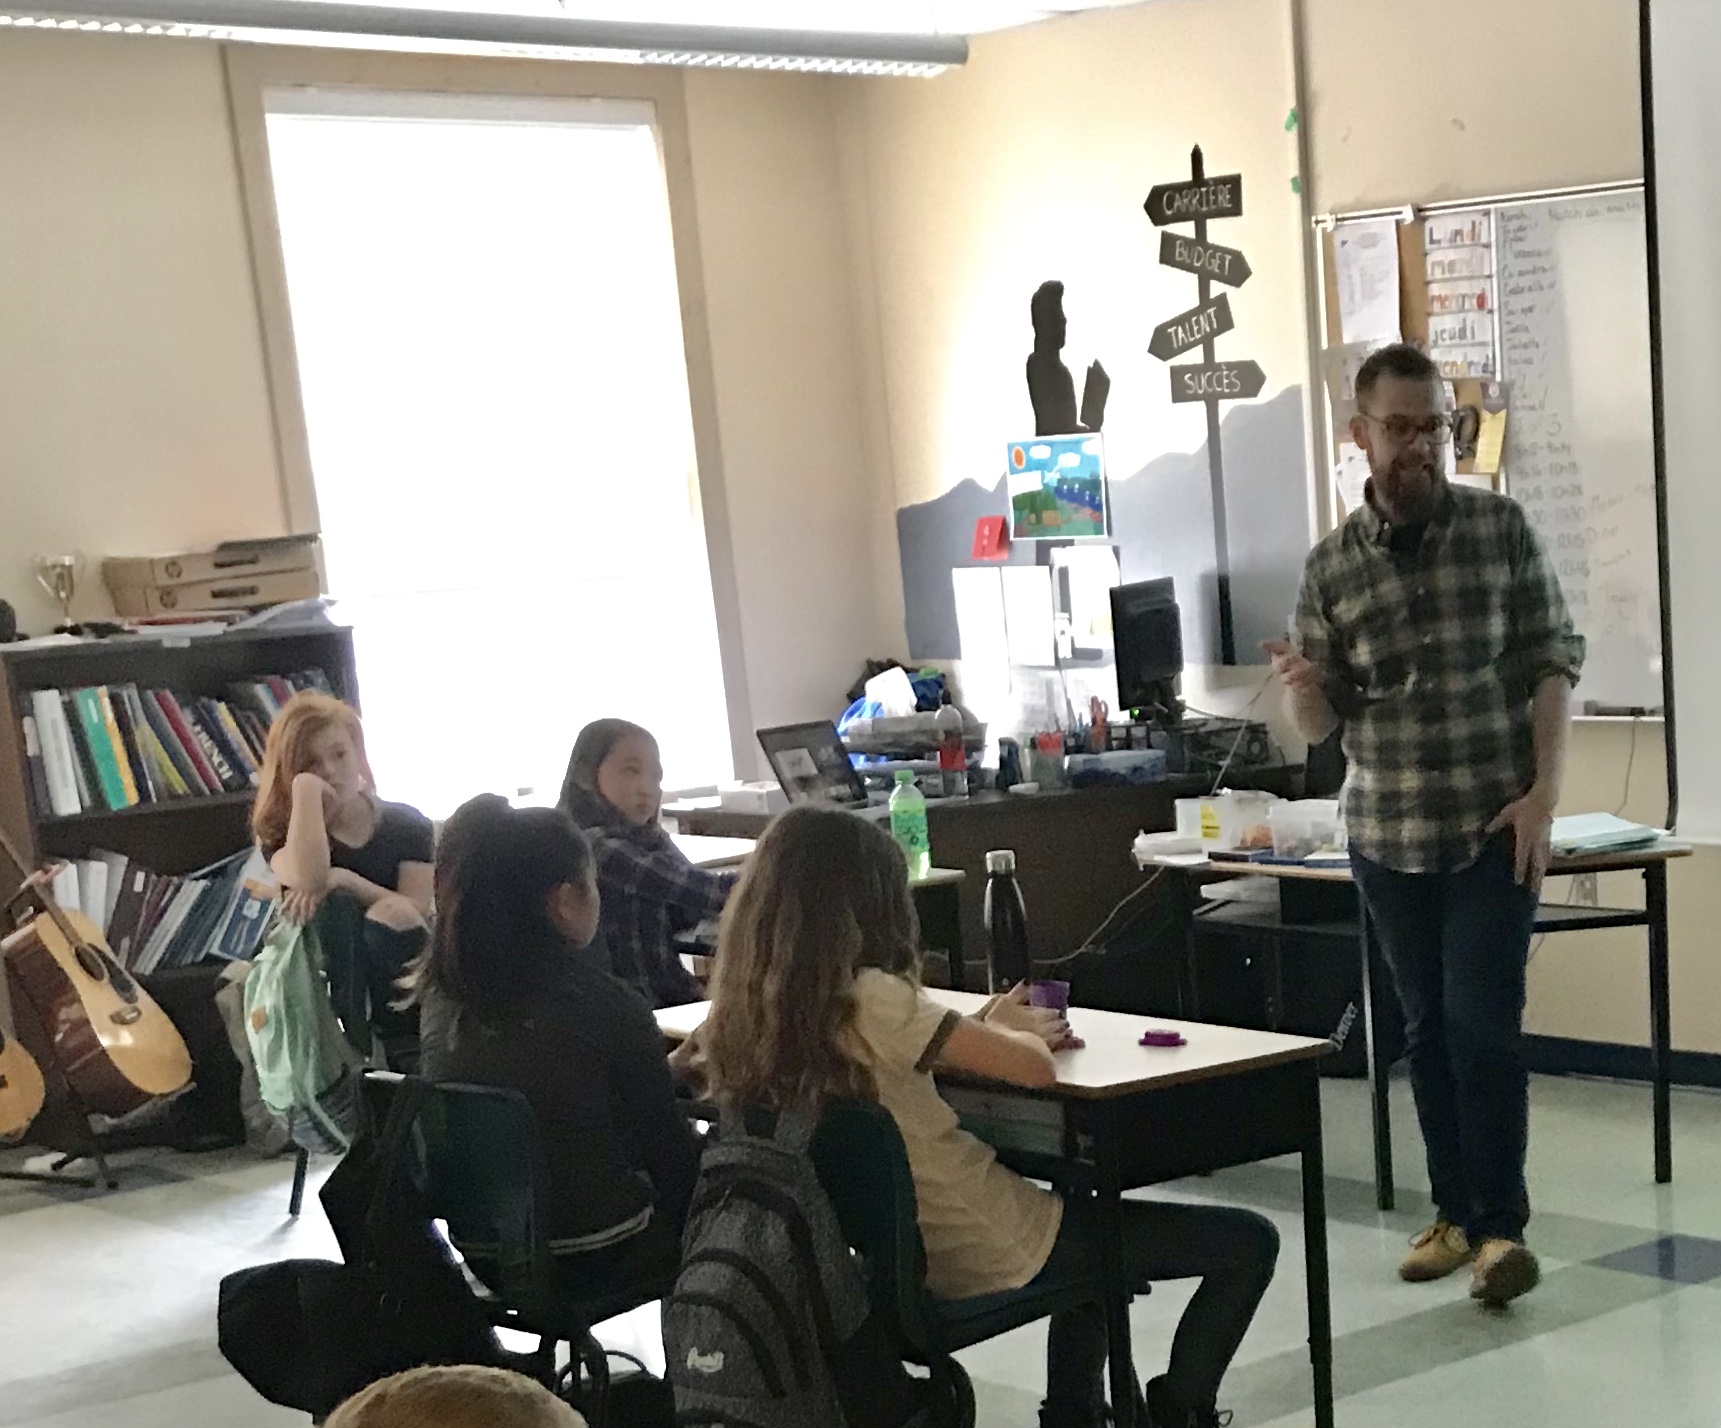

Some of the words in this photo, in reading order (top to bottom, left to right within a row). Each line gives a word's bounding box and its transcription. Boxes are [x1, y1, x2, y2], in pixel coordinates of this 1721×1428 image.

[1162, 180, 1232, 215] CARRIÈRE
[1175, 240, 1232, 275] BUDGET
[1167, 305, 1218, 349] TALENT
[1432, 317, 1476, 347] jeudi
[1184, 364, 1241, 394] SUCCÈS
